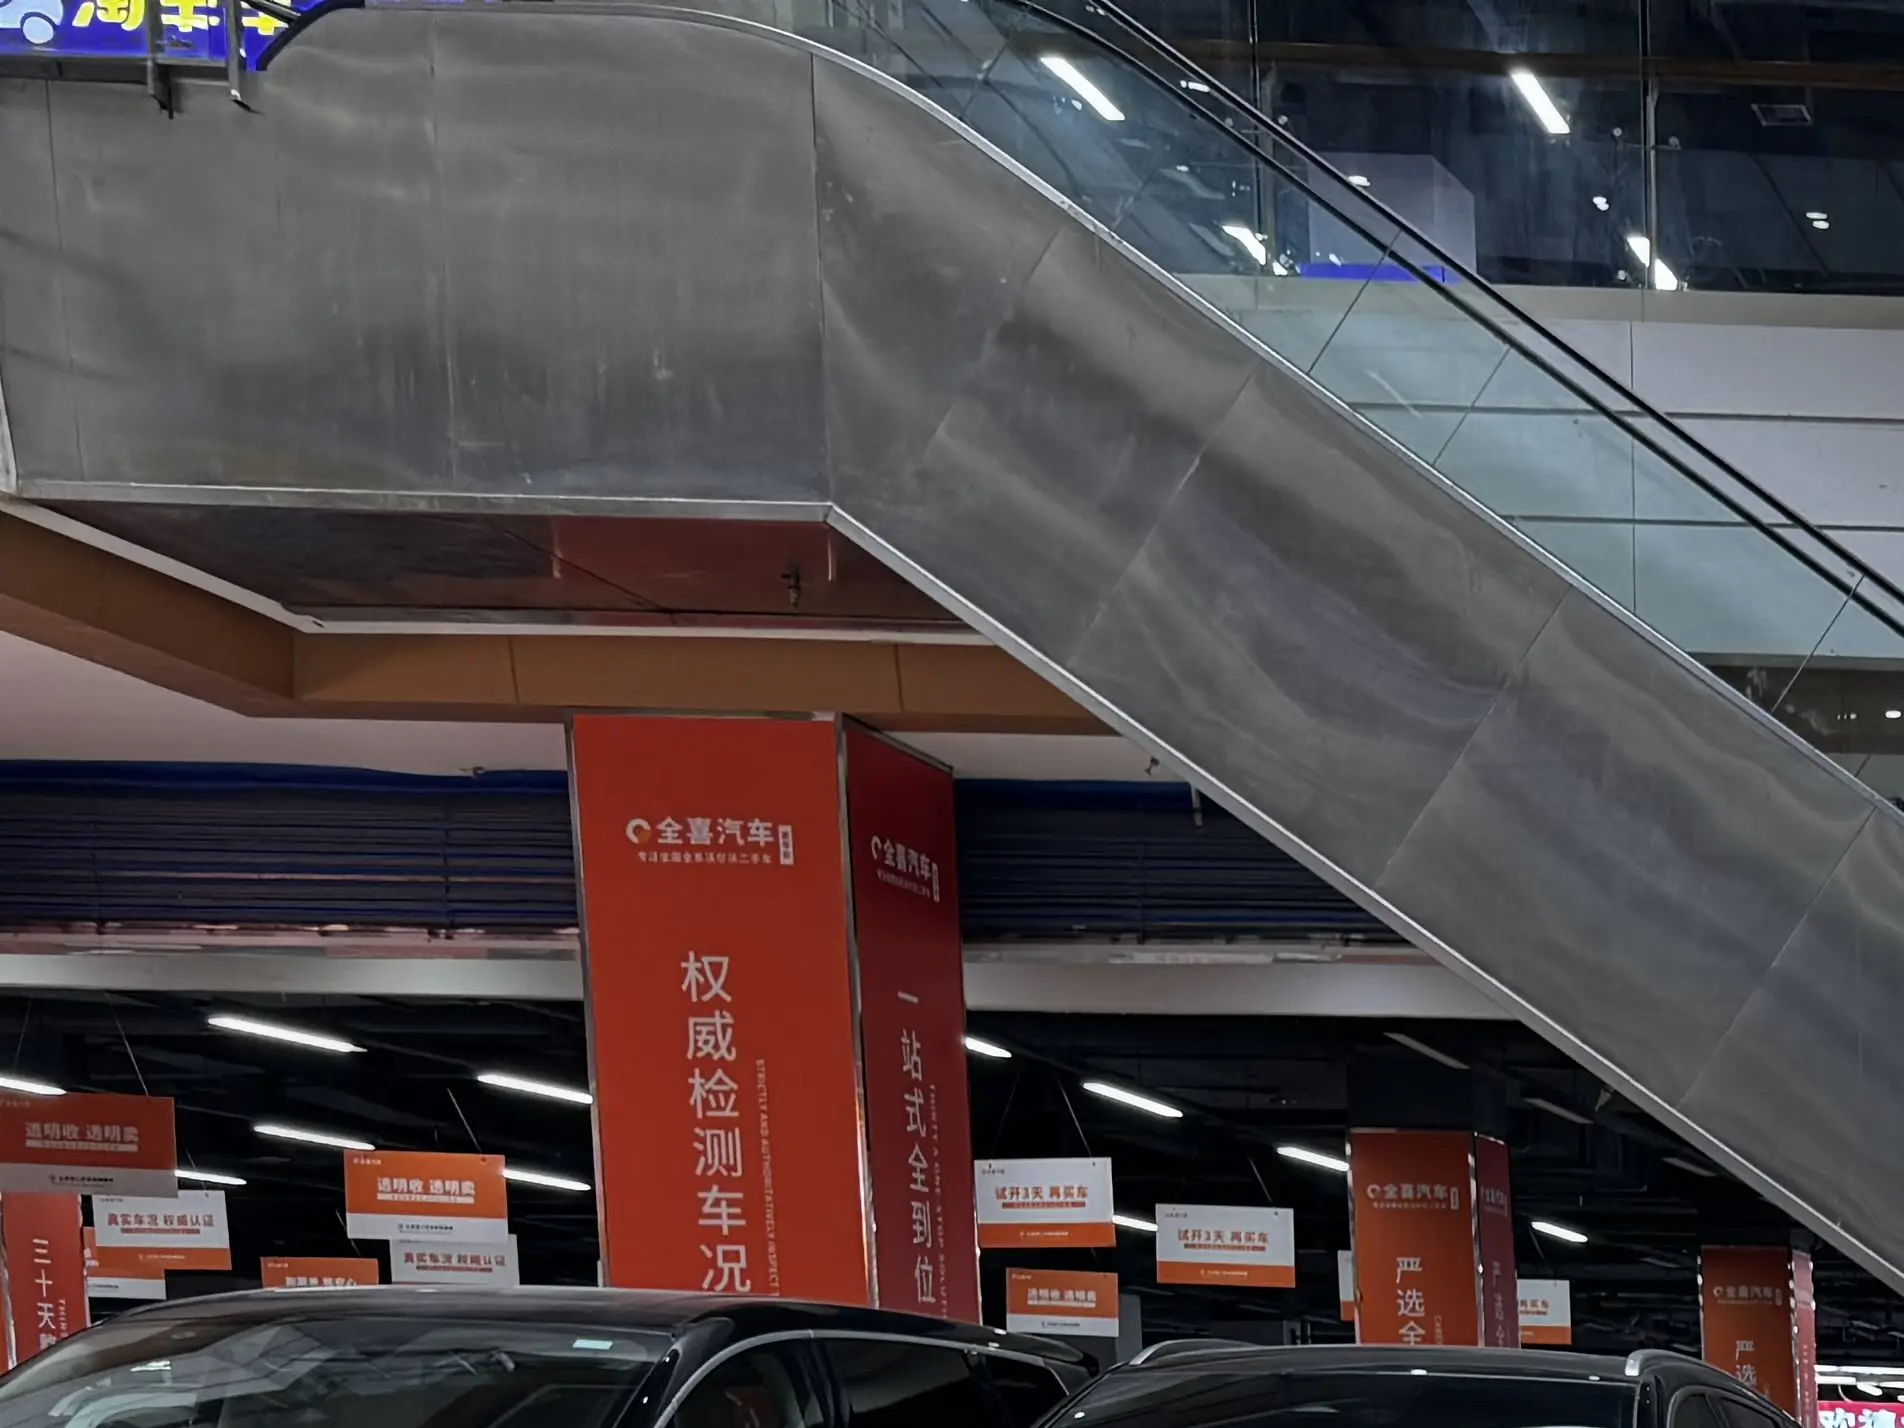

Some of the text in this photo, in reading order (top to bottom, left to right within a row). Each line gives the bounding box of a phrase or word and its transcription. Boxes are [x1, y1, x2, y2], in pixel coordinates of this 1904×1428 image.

[655, 816, 775, 847] 全喜汽车
[680, 950, 752, 1294] 权威检测车况
[897, 989, 936, 1304] 一站式全到位
